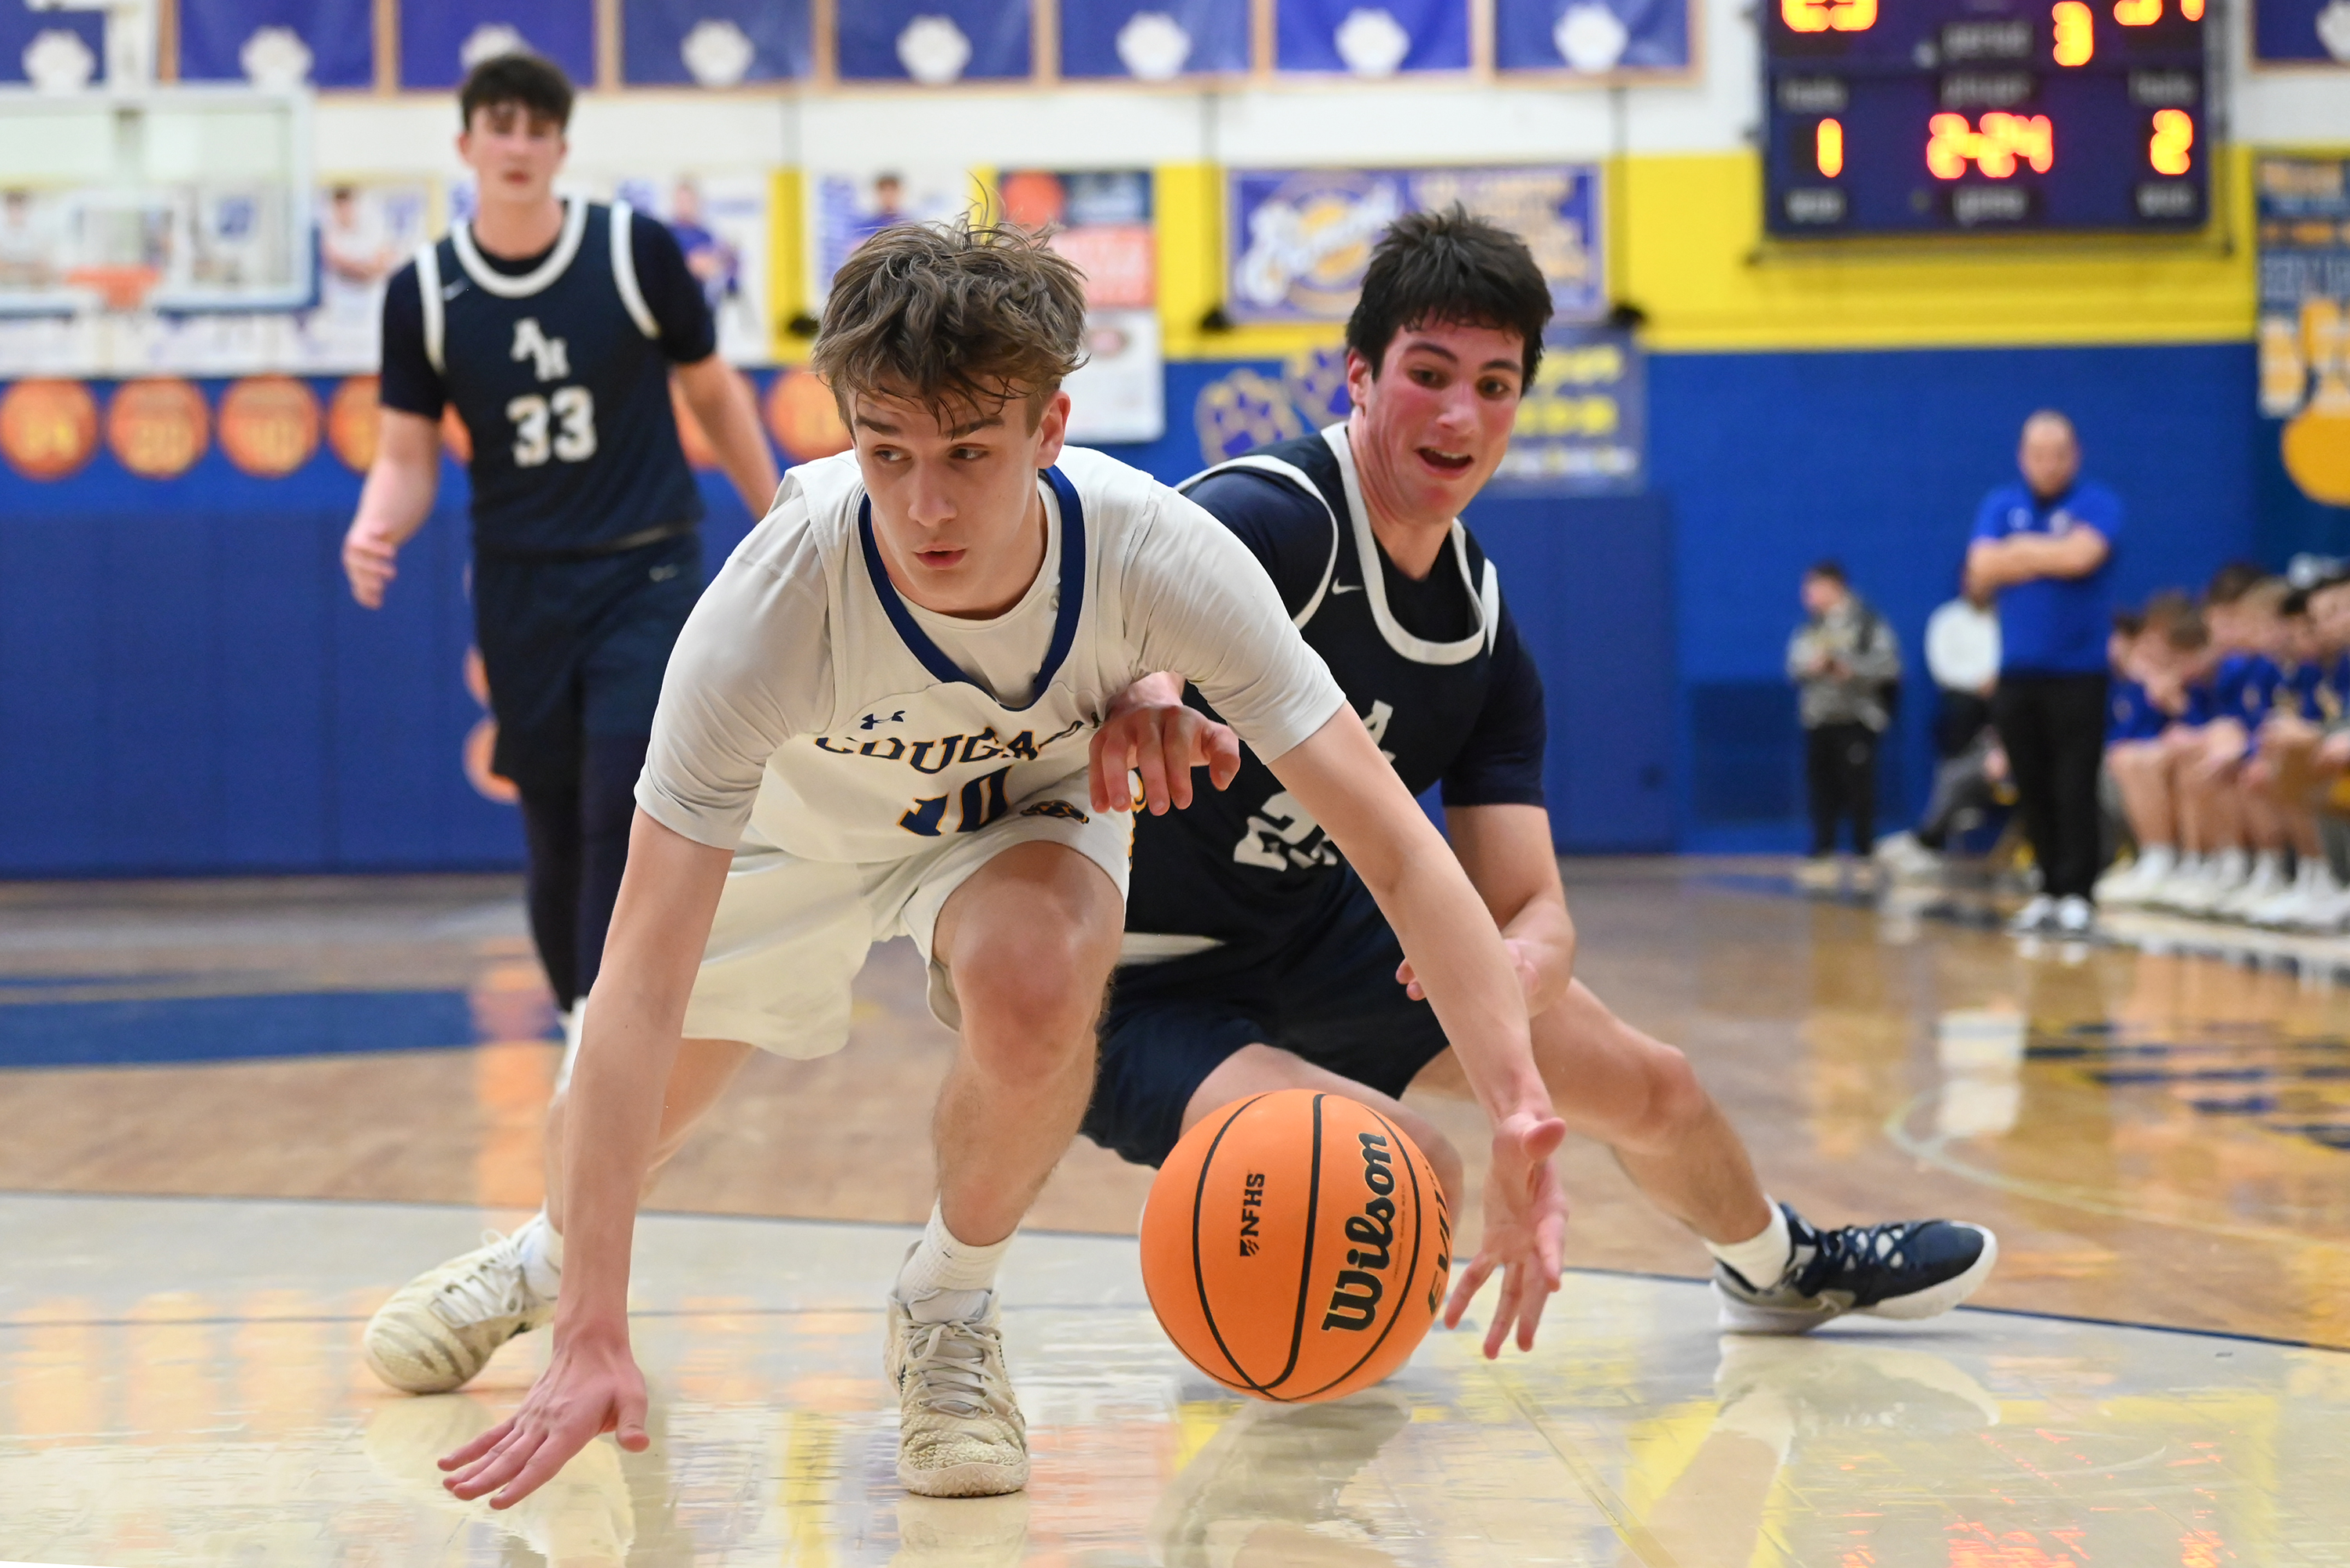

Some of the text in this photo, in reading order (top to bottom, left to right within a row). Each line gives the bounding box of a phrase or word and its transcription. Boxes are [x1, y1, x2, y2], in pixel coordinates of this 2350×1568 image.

[2052, 1, 2093, 66] 3
[1817, 118, 1842, 177] 1
[2150, 110, 2193, 174] 2
[506, 385, 598, 468] 33
[1241, 1172, 1265, 1237] NFHS
[1321, 1132, 1396, 1332] Wilson
